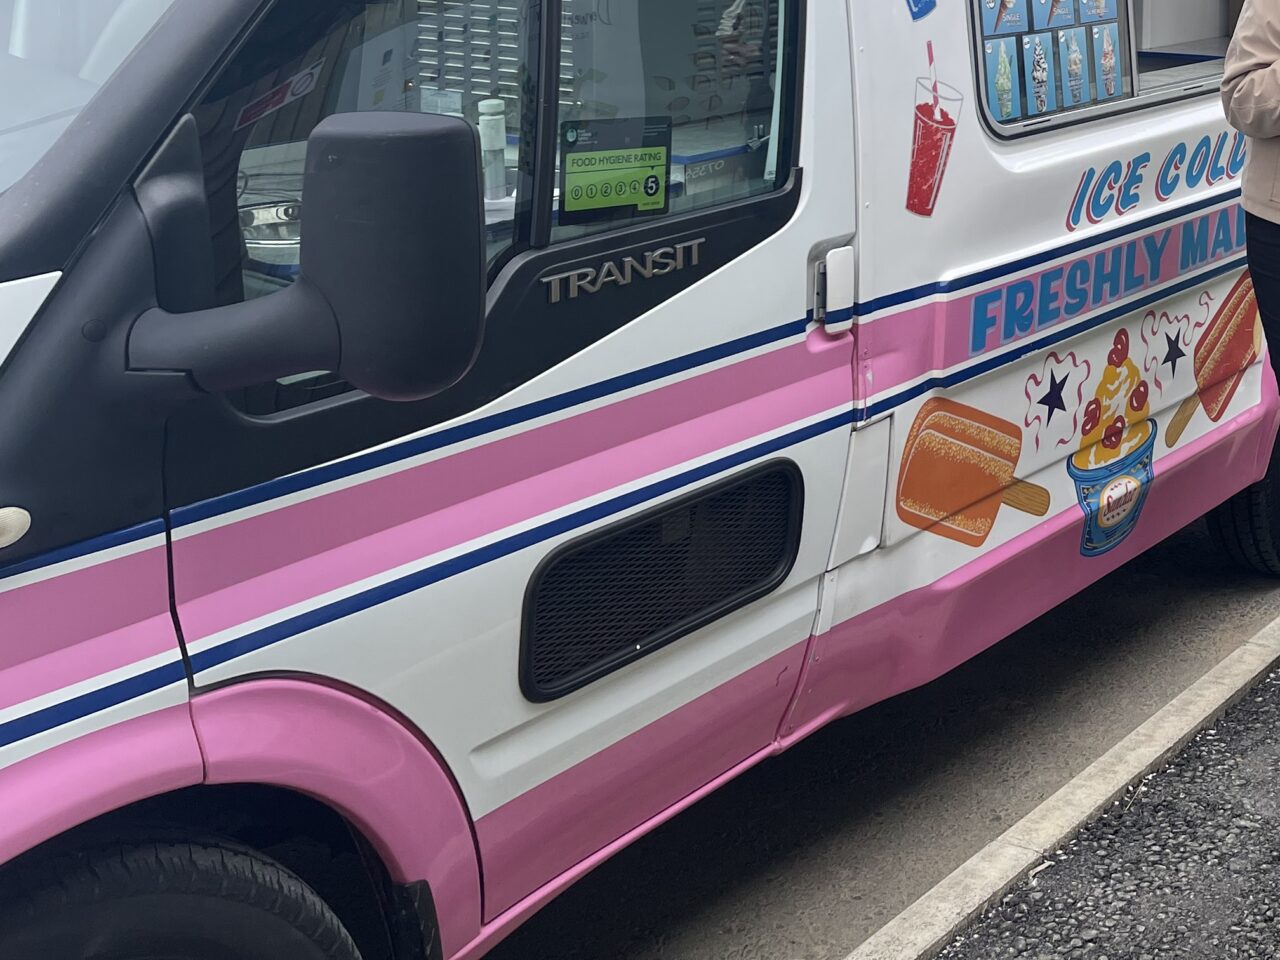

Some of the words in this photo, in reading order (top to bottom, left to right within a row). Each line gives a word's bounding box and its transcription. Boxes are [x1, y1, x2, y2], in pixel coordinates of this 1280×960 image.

[571, 156, 597, 168] FOOD
[598, 154, 633, 166] HYGIENE
[634, 152, 662, 164] RATING
[1066, 151, 1151, 232] ICE
[540, 237, 706, 303] TRANSIT
[968, 227, 1173, 356] FRESHLY
